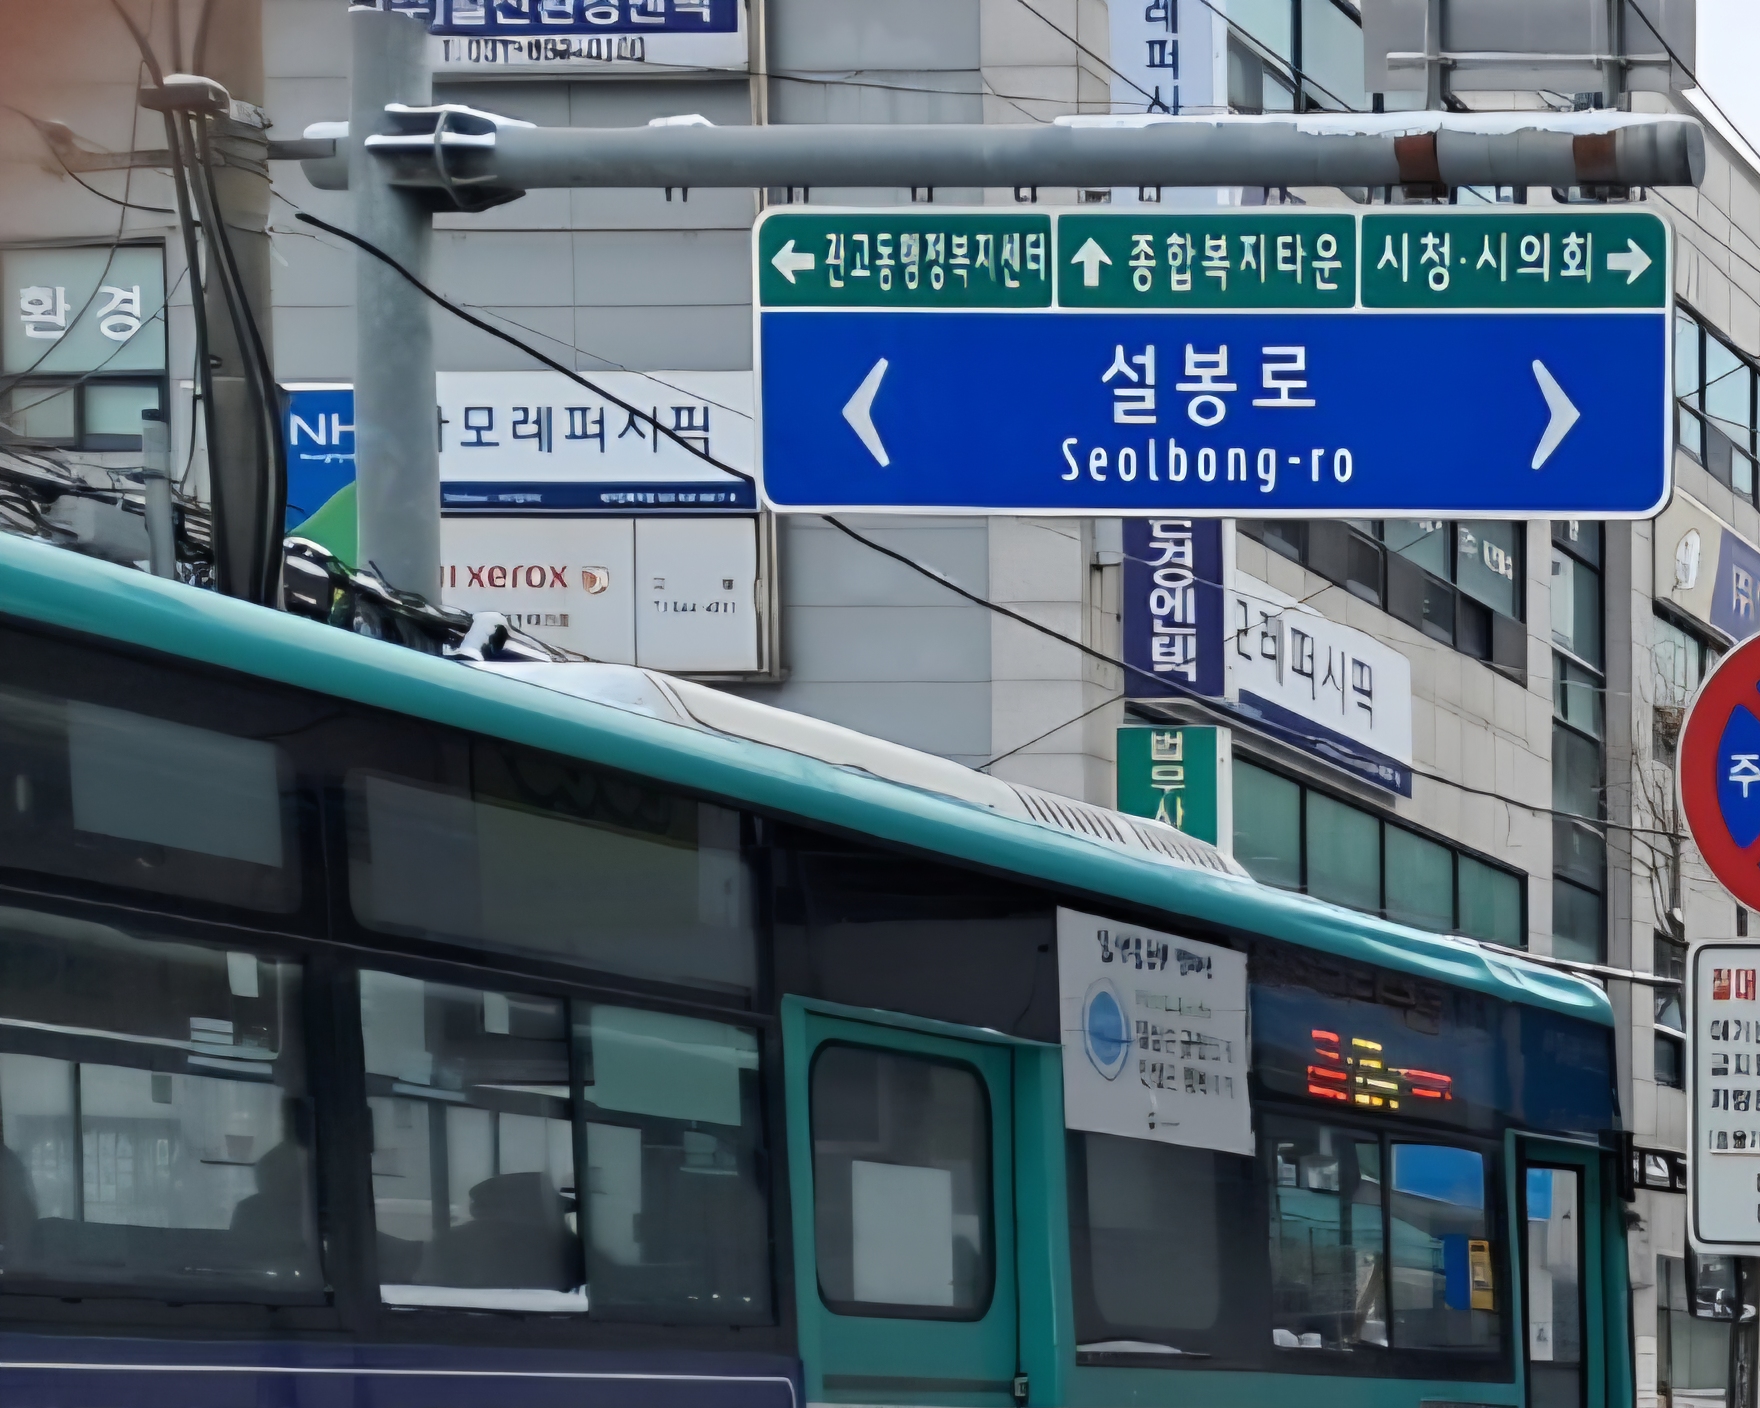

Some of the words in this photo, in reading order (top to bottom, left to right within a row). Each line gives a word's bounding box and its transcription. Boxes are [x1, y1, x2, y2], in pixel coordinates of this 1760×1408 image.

[1128, 232, 1342, 292] 종합복지타운
[1377, 231, 1593, 292] 시청·시의회
[1102, 343, 1316, 427] 설봉로
[1061, 437, 1353, 493] Seolbong-ro
[467, 564, 569, 588] xerox
